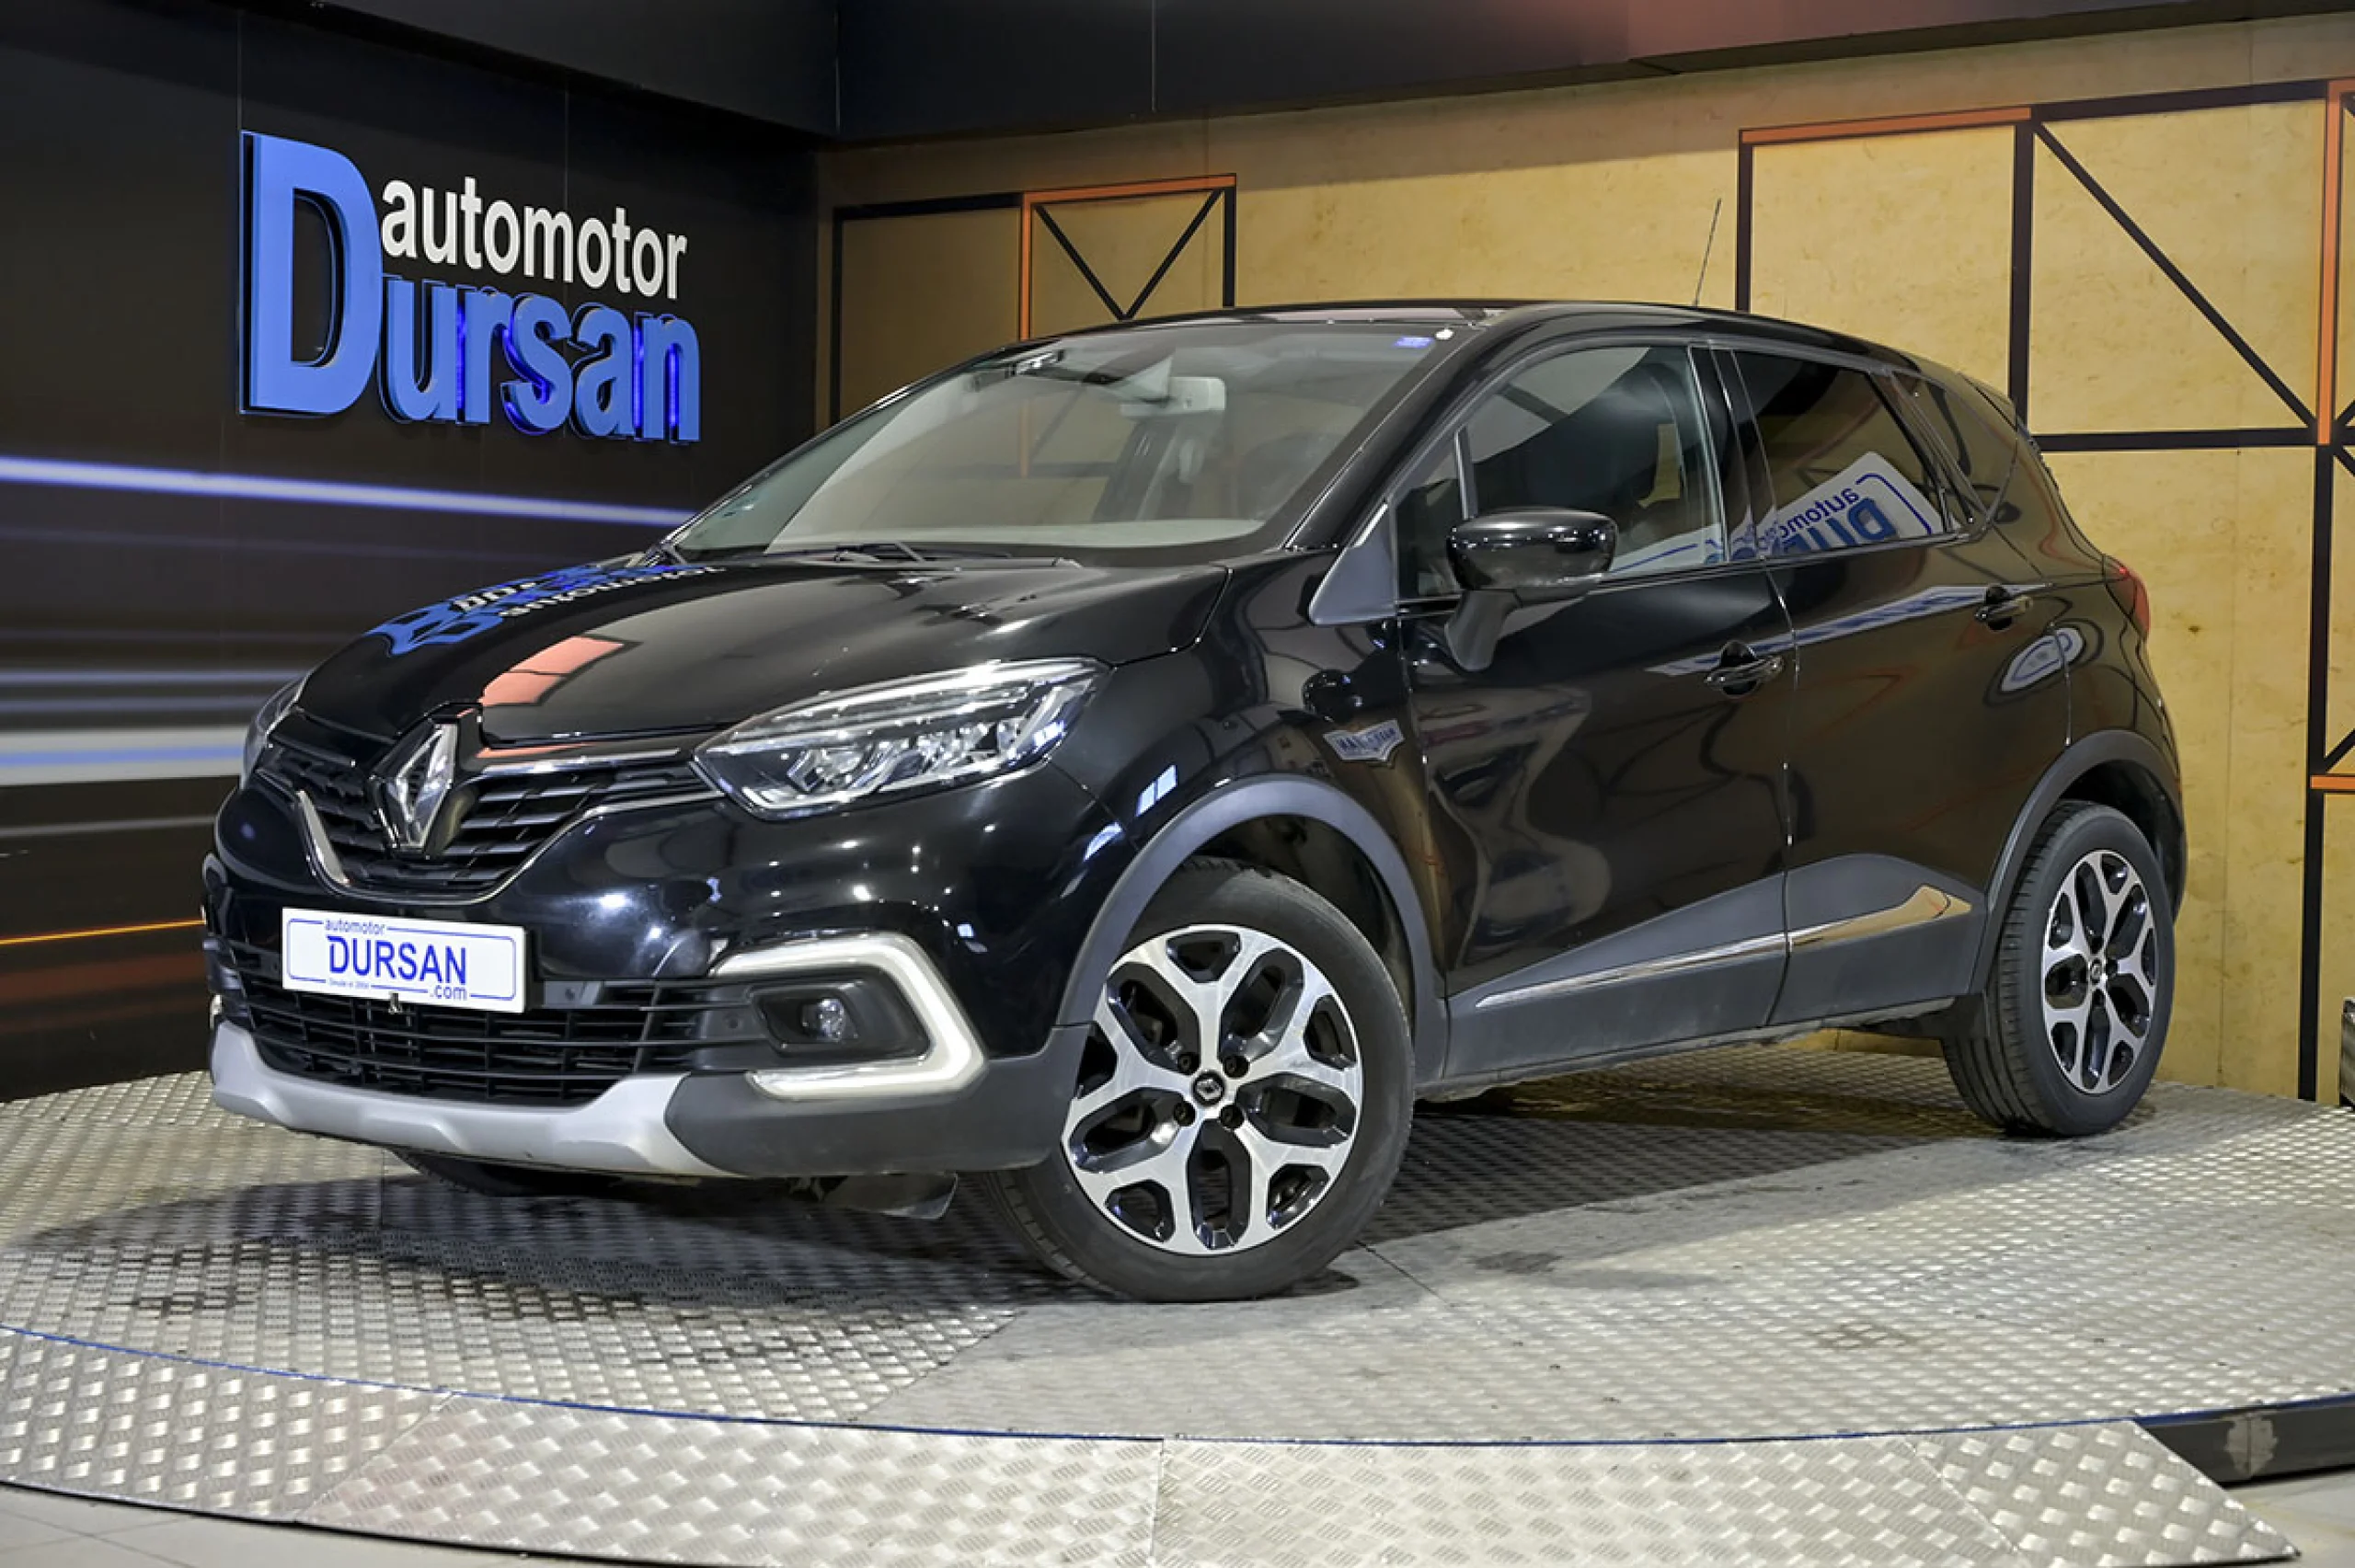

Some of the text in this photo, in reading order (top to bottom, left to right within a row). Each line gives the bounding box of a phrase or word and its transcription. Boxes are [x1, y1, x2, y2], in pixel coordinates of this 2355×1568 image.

[381, 176, 688, 299] automotor
[240, 130, 701, 443] Dursan
[325, 920, 385, 935] automotor
[327, 935, 466, 984] DURSAN
[430, 985, 467, 1000] .com
